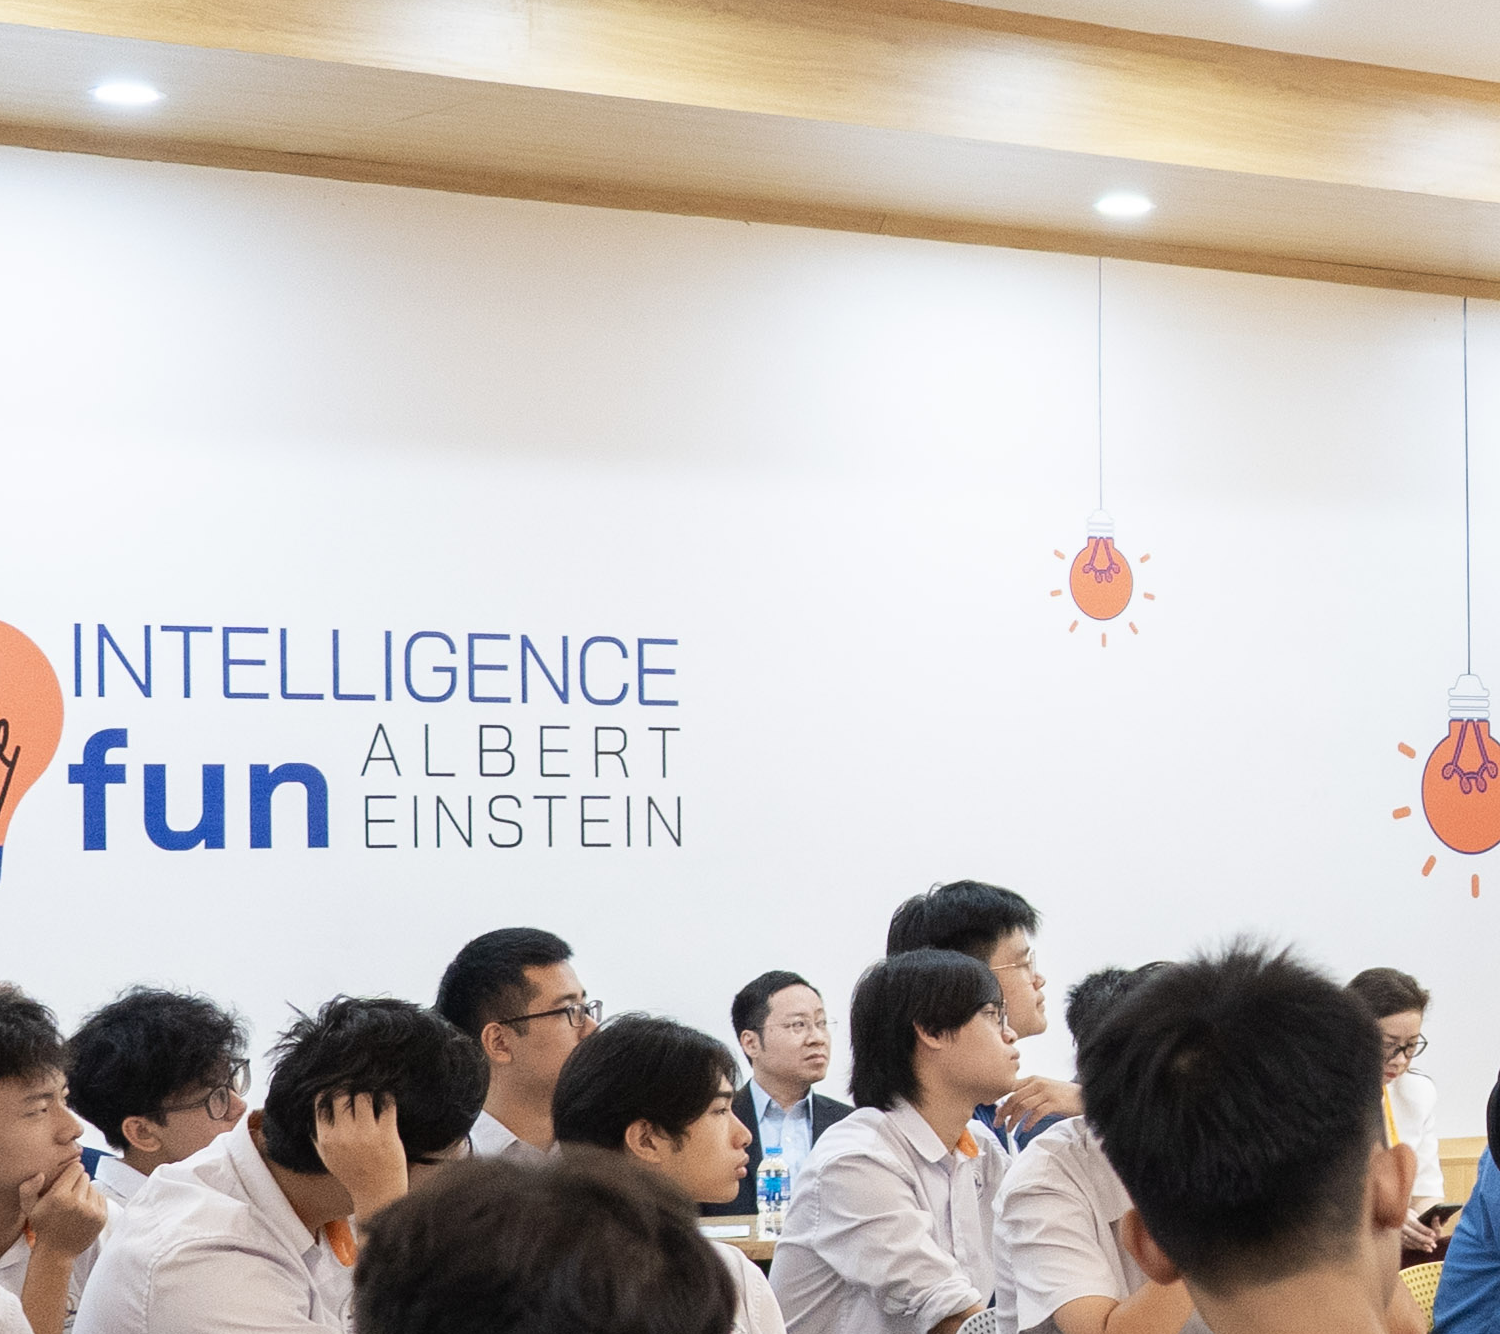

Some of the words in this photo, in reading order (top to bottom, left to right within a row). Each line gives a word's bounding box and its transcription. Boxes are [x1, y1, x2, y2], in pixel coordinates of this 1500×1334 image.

[73, 622, 680, 707] INTELLIGENCE
[360, 723, 682, 779] ALBERT
[67, 727, 330, 852] fun
[363, 794, 683, 849] EINSTEIN
